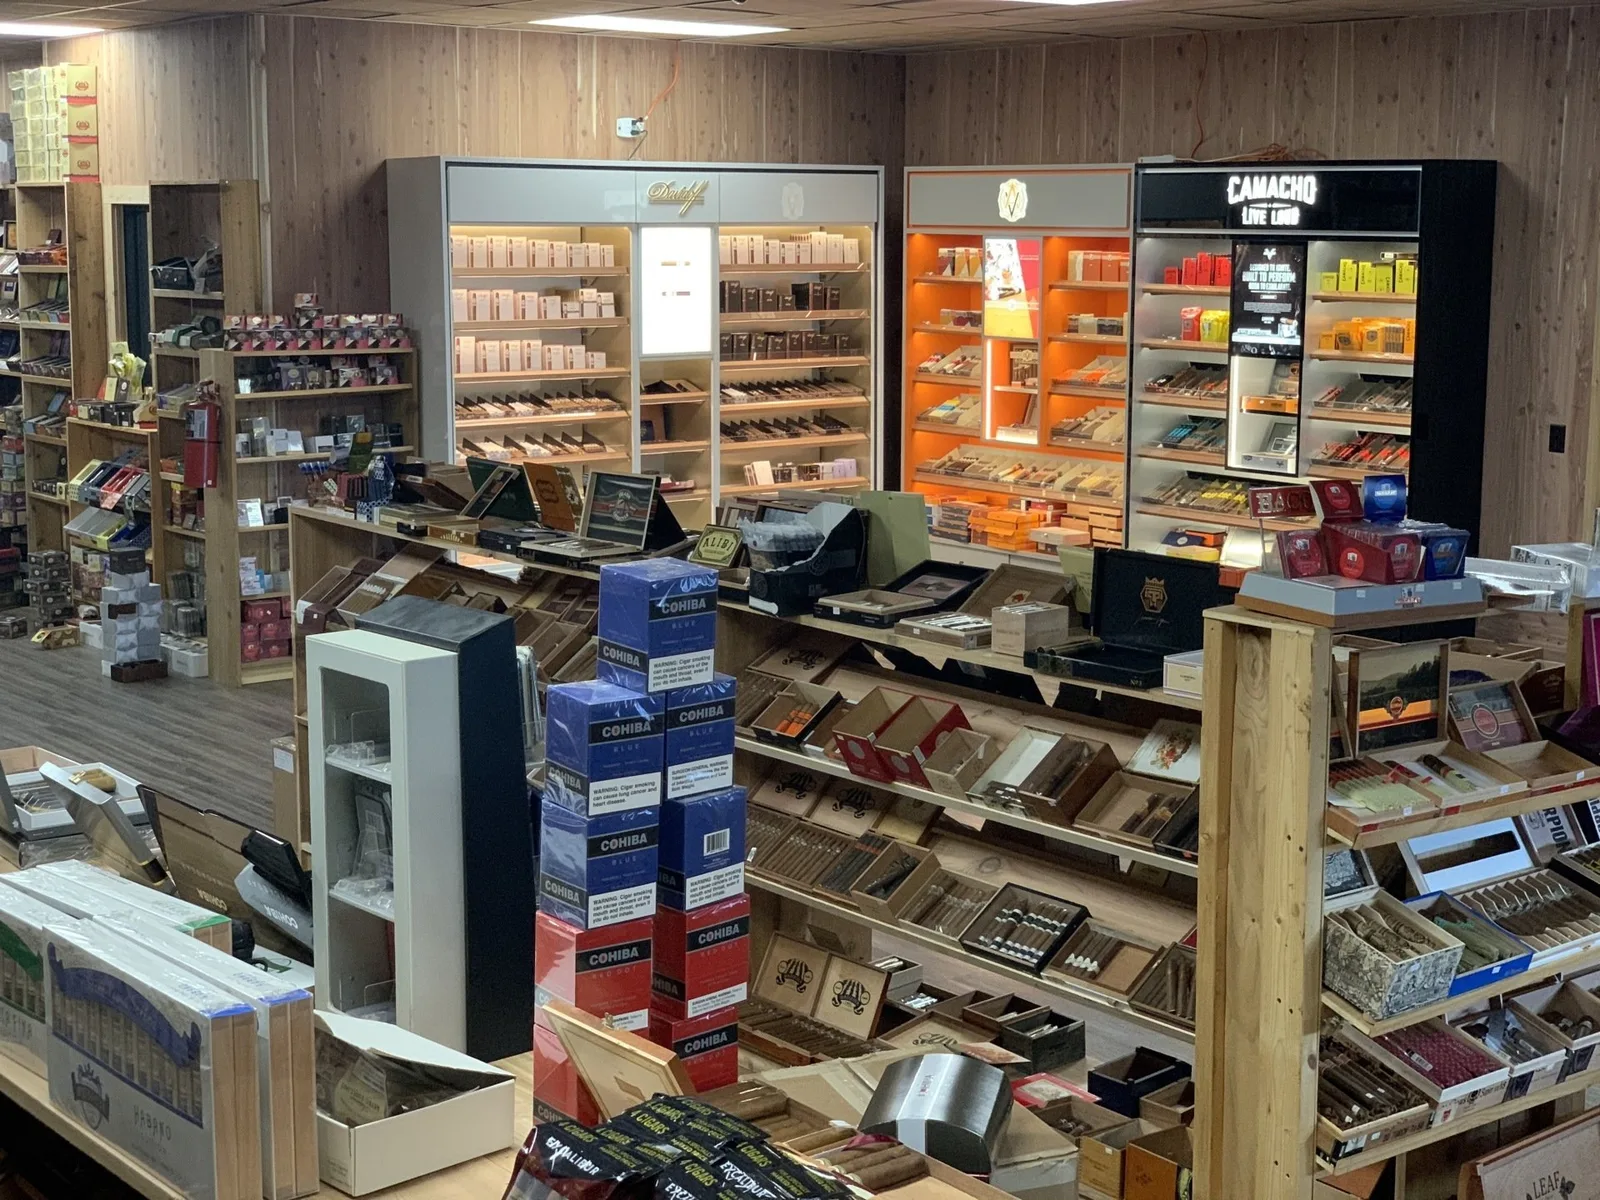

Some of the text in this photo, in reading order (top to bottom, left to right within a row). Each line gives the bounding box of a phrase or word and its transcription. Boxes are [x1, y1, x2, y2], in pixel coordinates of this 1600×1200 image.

[647, 180, 709, 215] Davidoff
[1227, 175, 1317, 205] CAMACHO
[1242, 206, 1267, 225] LIVE
[702, 536, 734, 551] ALIBI
[661, 598, 706, 614] COHIBA
[603, 645, 640, 667] COHIBA
[679, 705, 724, 722] COHIBA
[602, 722, 651, 738] COHIBA
[1543, 807, 1574, 853] RPION
[601, 832, 648, 852] COHIBA
[659, 871, 676, 886] IBA
[545, 880, 580, 903] COHIBA
[698, 924, 740, 944] COHIBA
[589, 947, 639, 966] COHIBA
[654, 977, 679, 995] HIBA
[684, 1032, 728, 1053] COHIBA
[537, 1105, 563, 1121] COHI
[564, 1125, 598, 1143] CIGARS
[636, 1113, 670, 1135] CIGARS
[600, 1129, 634, 1146] CIGARS
[740, 1145, 772, 1168] CIGARS
[684, 1163, 718, 1187] CIGARS
[1532, 1170, 1560, 1199] LEAF
